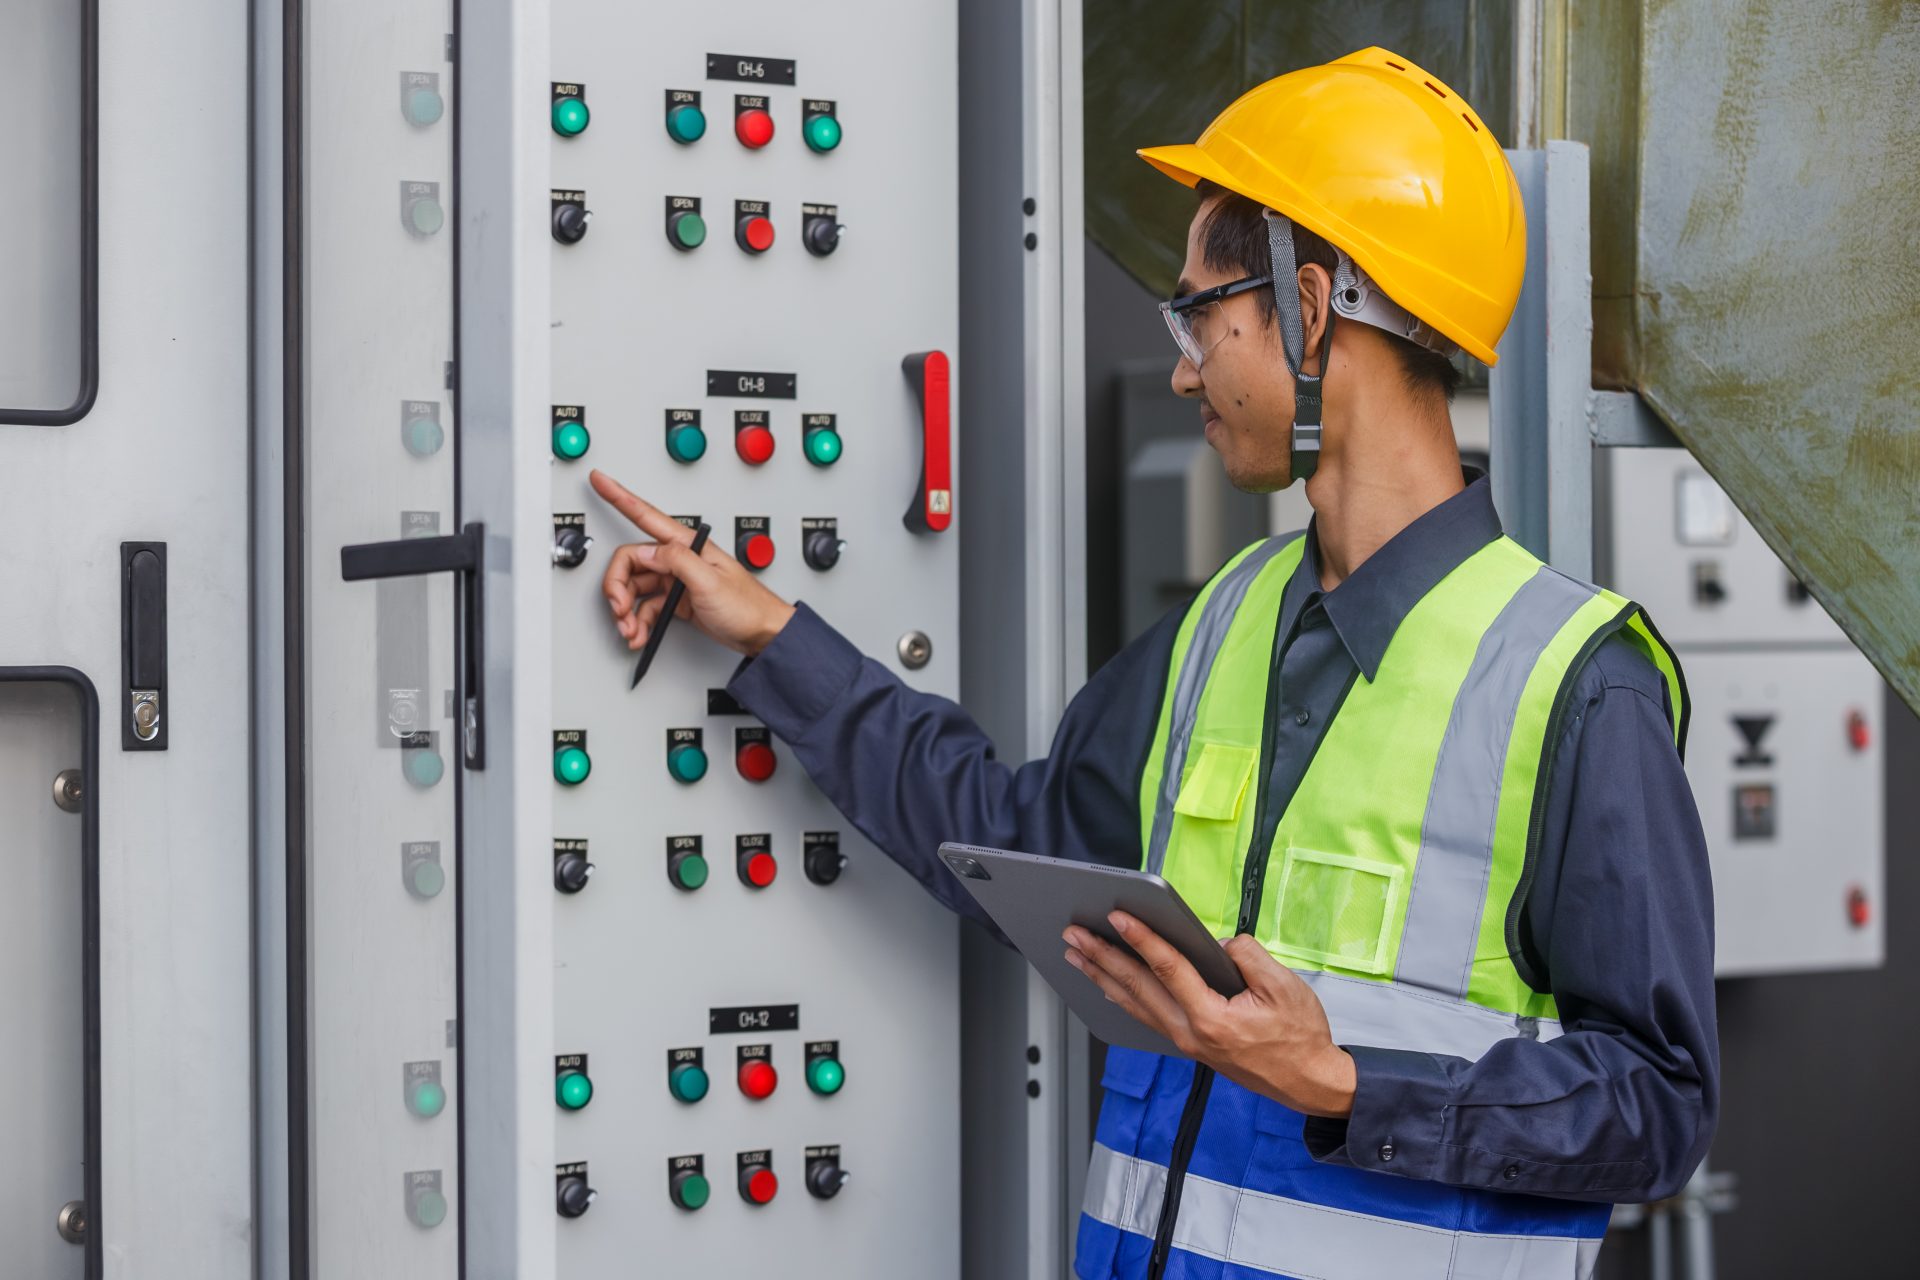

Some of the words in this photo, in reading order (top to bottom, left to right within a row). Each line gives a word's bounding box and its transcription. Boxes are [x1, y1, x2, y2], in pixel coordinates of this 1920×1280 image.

[738, 61, 765, 78] CH-6
[409, 74, 430, 84] OPEN
[556, 85, 578, 96] AUTO
[673, 92, 694, 103] OPEN
[741, 97, 763, 108] CLOSE
[809, 102, 830, 111] AUTO
[409, 184, 430, 193] OPEN
[673, 198, 694, 209] OPEN
[741, 201, 764, 213] CLOSE
[738, 377, 765, 393] CH-8
[410, 403, 431, 413] OPEN
[556, 407, 578, 418] AUTO
[673, 411, 694, 422] OPEN
[741, 413, 763, 423] CLOSE
[809, 415, 830, 426] AUTO
[410, 514, 431, 524] OPEN
[741, 519, 764, 529] CLOSE
[411, 734, 431, 744] OPEN
[558, 732, 579, 742] AUTO
[674, 730, 695, 741] OPEN
[674, 838, 695, 849] OPEN
[742, 836, 765, 847] CLOSE
[411, 844, 432, 854] OPEN
[739, 1011, 770, 1028] CH-12
[743, 1046, 766, 1057] CLOSE
[811, 1043, 832, 1053] AUTO
[559, 1056, 581, 1066] AUTO
[675, 1050, 696, 1061] OPEN
[412, 1063, 432, 1074] OPEN
[675, 1157, 696, 1168] OPEN
[742, 1152, 766, 1163] CLOSE
[414, 1173, 433, 1184] OPEN
